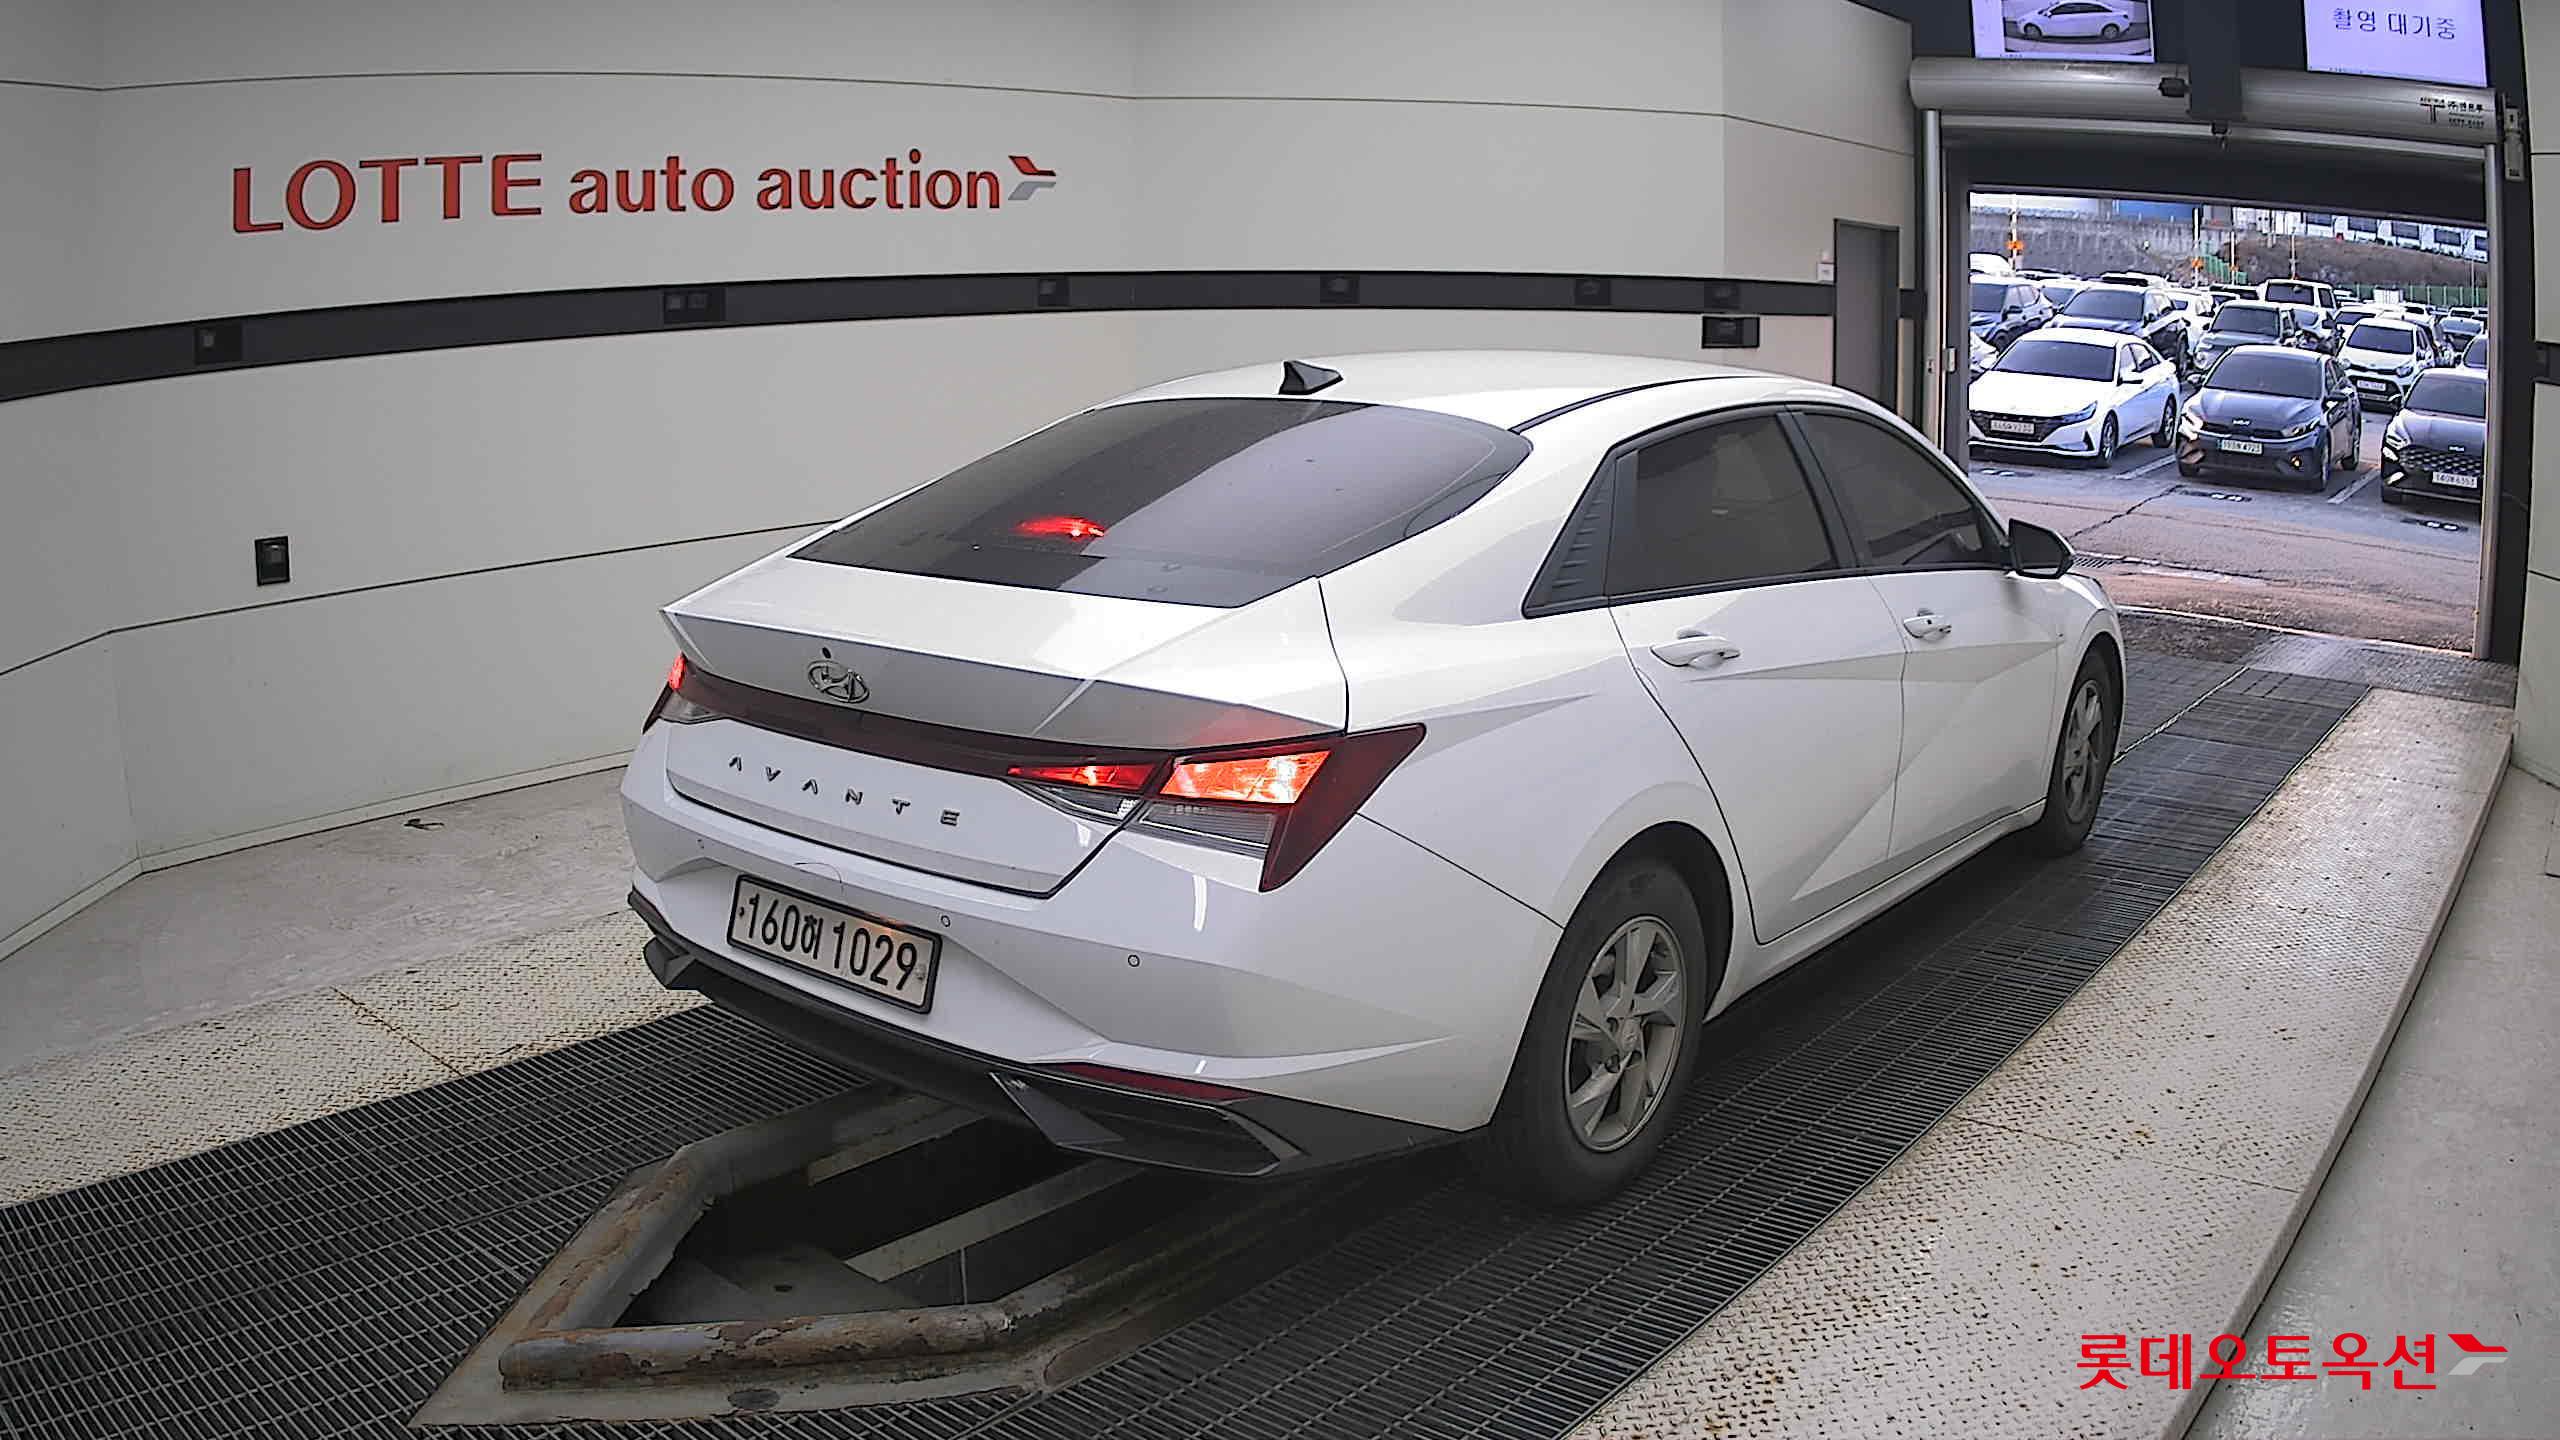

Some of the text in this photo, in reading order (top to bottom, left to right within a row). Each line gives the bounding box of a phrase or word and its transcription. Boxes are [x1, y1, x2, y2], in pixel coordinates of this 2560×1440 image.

[2333, 7, 2456, 40] 촬영 대기중
[233, 147, 1003, 234] LOTTE auto auction
[729, 756, 960, 826] AVANTE
[833, 921, 917, 990] 1029
